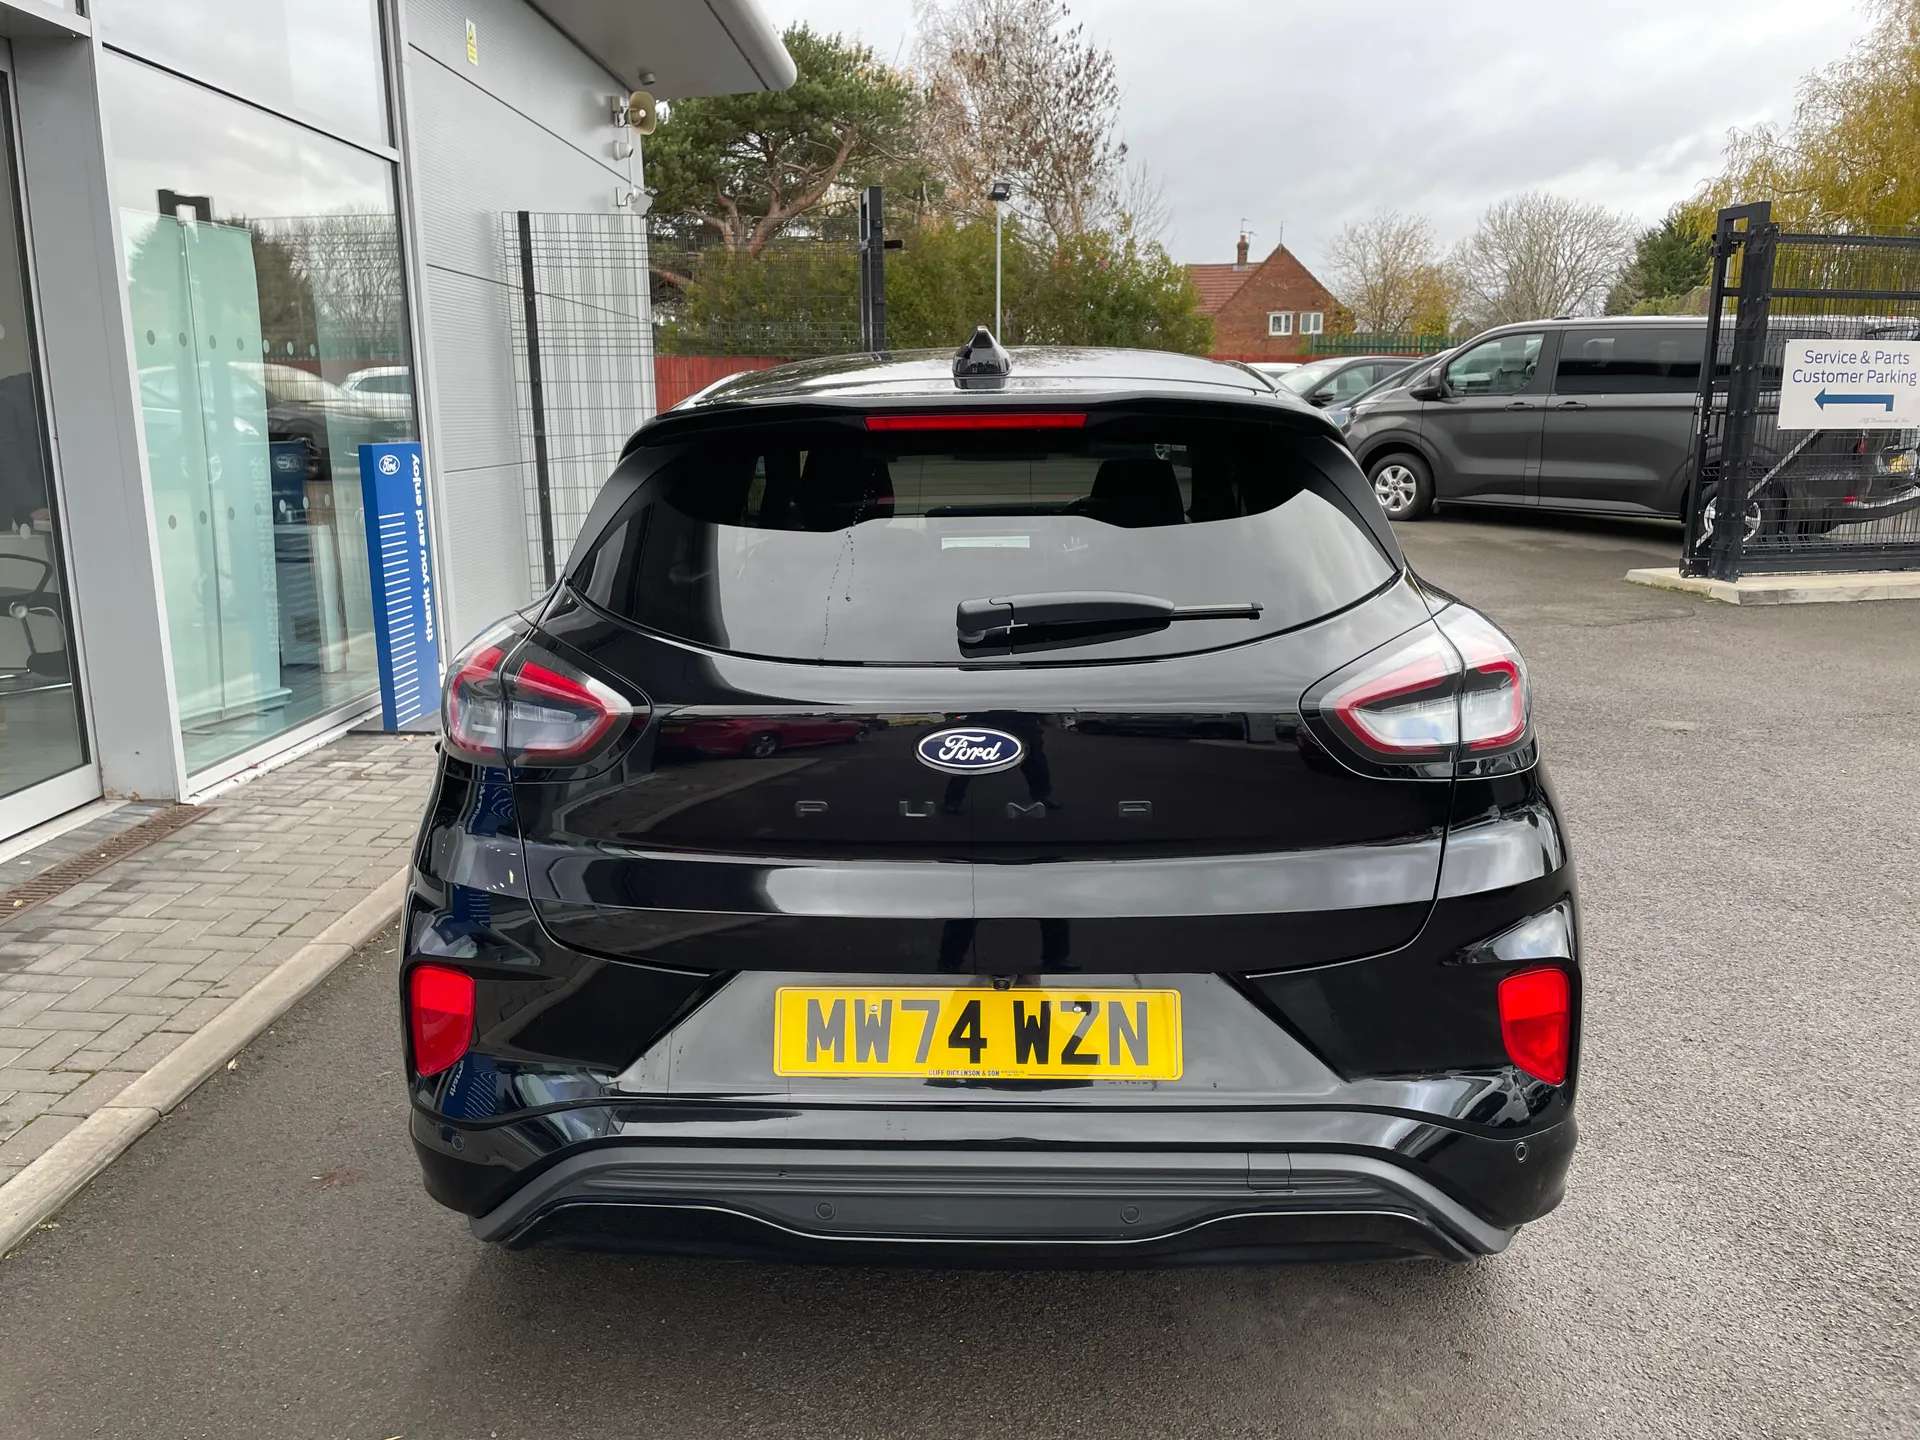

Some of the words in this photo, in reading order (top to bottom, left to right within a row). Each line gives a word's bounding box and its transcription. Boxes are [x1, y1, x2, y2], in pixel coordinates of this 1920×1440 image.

[1804, 350, 1856, 364] Service
[1860, 350, 1870, 364] &
[1874, 350, 1910, 365] Parts
[1792, 369, 1864, 383] Customer
[1867, 369, 1917, 386] Parking
[411, 453, 423, 507] enjoy
[415, 510, 426, 546] and
[419, 548, 430, 584] you
[422, 589, 434, 643] thank
[937, 733, 1001, 762] Ford
[794, 800, 1153, 818] PUMA
[806, 998, 988, 1064] MW74
[1013, 1000, 1149, 1065] WZN
